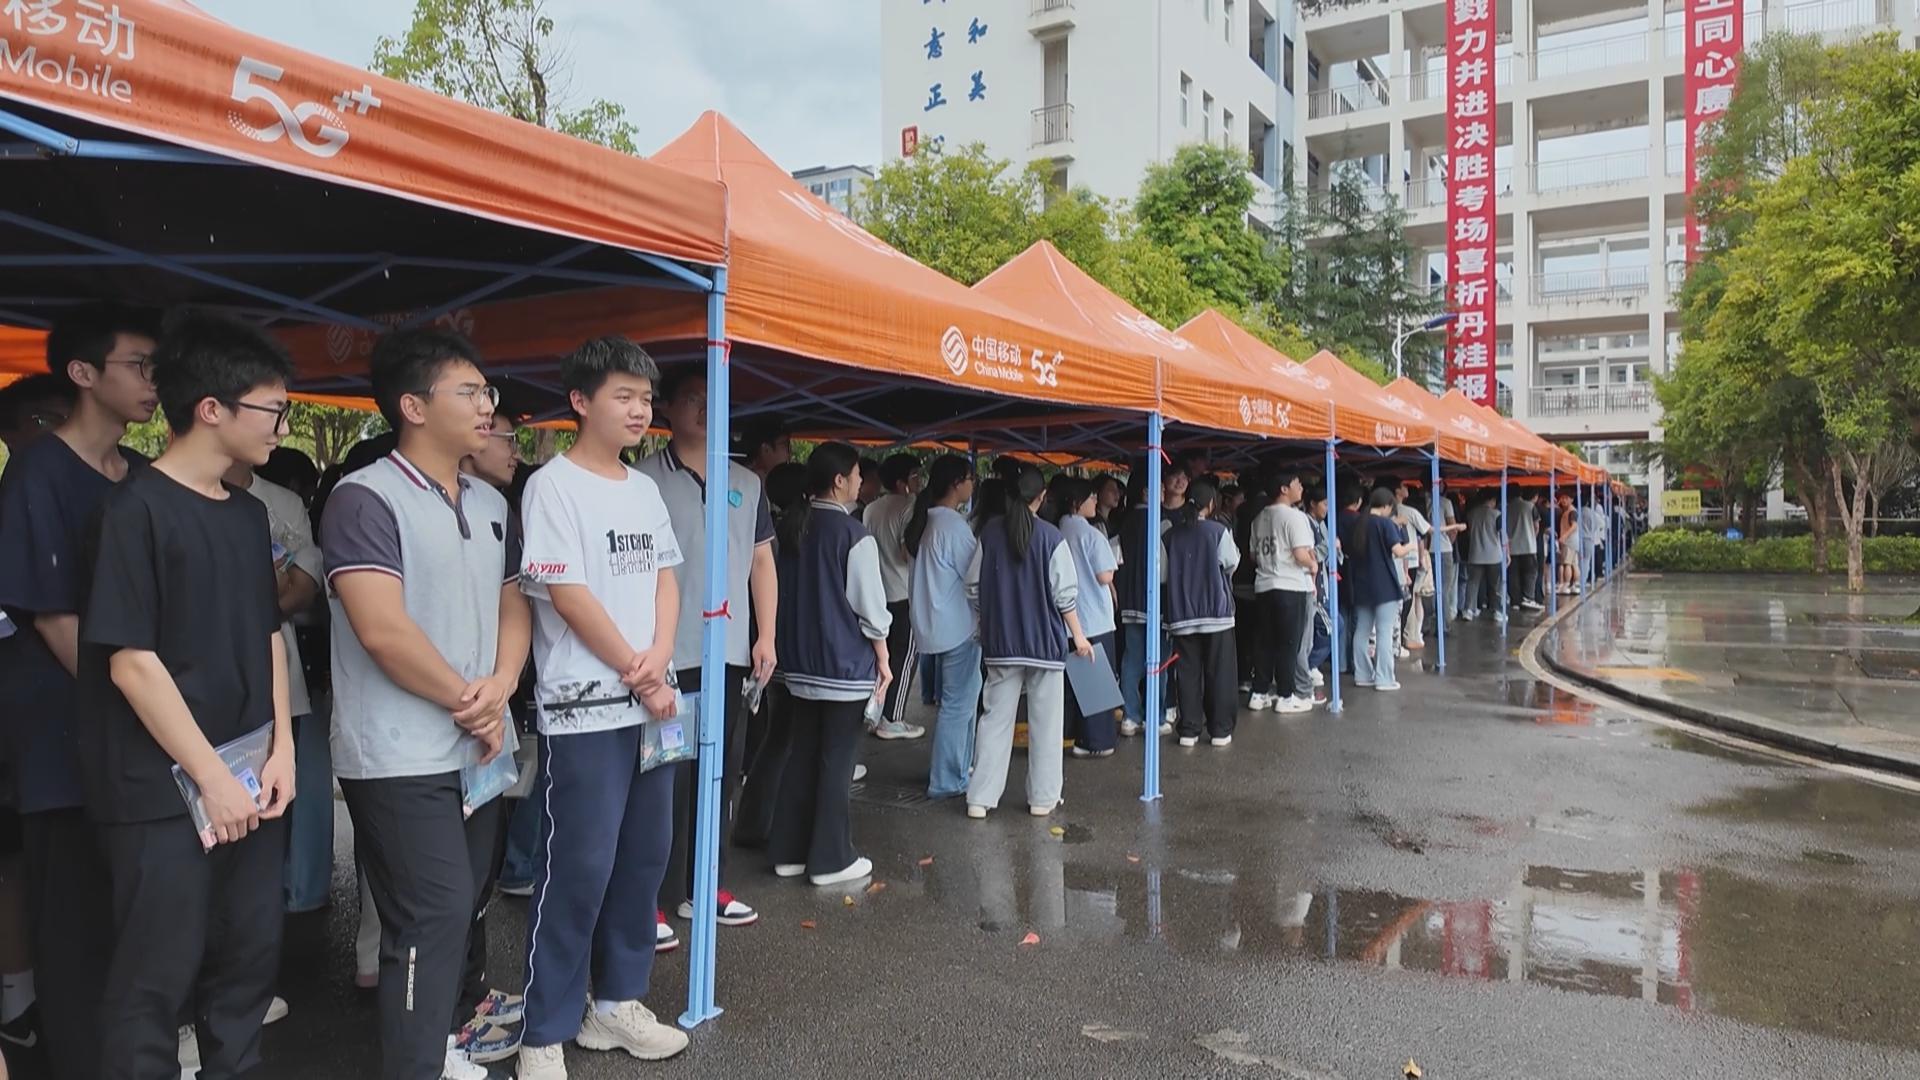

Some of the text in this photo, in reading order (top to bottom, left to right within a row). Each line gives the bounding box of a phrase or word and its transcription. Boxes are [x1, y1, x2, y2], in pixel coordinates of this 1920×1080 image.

[0, 38, 132, 103] Mobile
[923, 0, 947, 155] 意正心
[971, 334, 1021, 366] 中国移动
